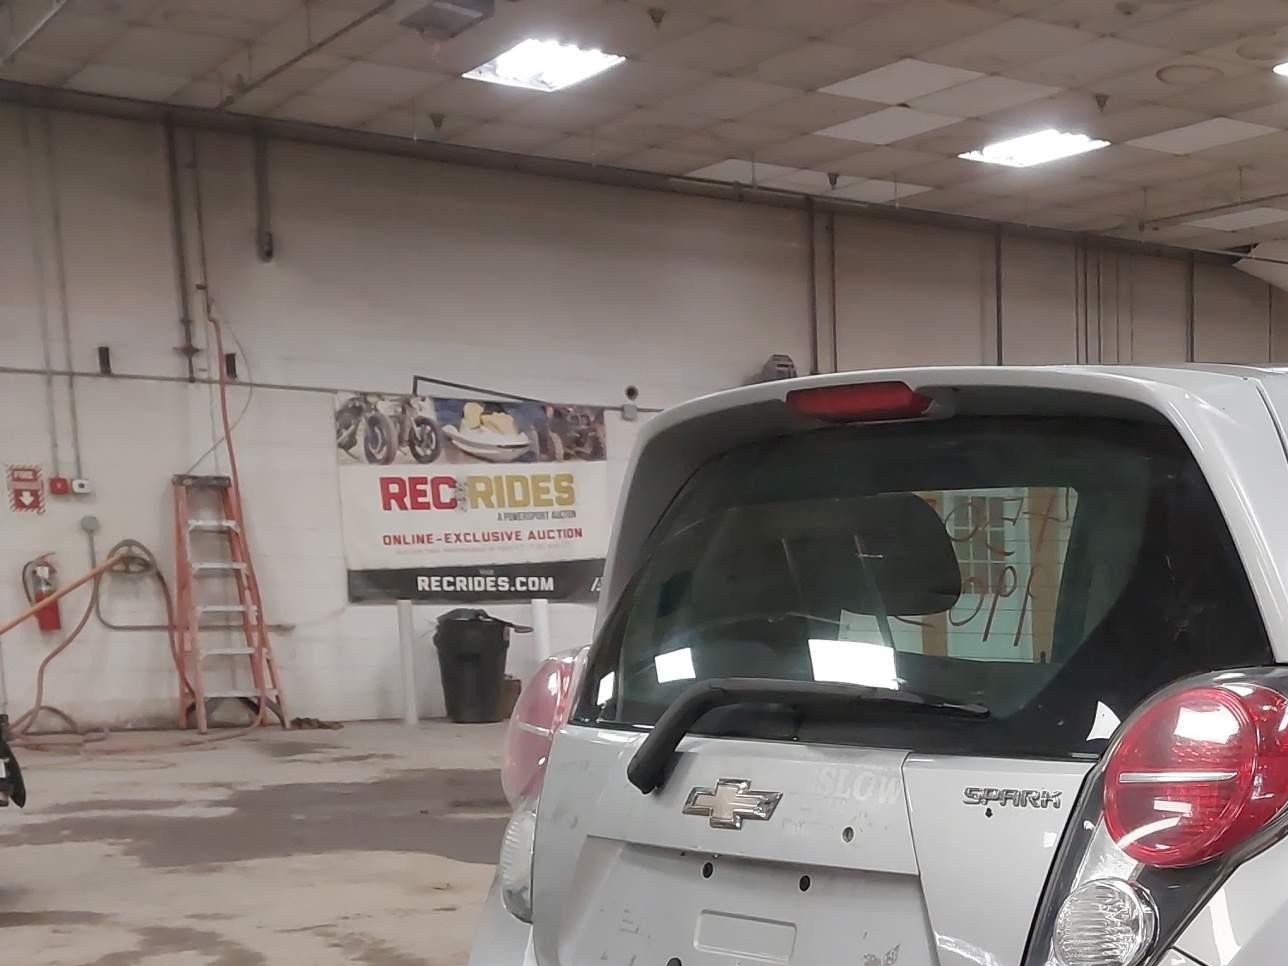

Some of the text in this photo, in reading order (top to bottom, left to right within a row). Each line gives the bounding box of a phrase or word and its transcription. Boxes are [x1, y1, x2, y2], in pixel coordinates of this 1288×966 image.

[467, 473, 576, 509] RIDES
[382, 528, 583, 546] ONLINE-EXCLUSIVE AUCTION
[416, 576, 554, 592] RECRIDES.COM
[962, 787, 1062, 809] SPARK
